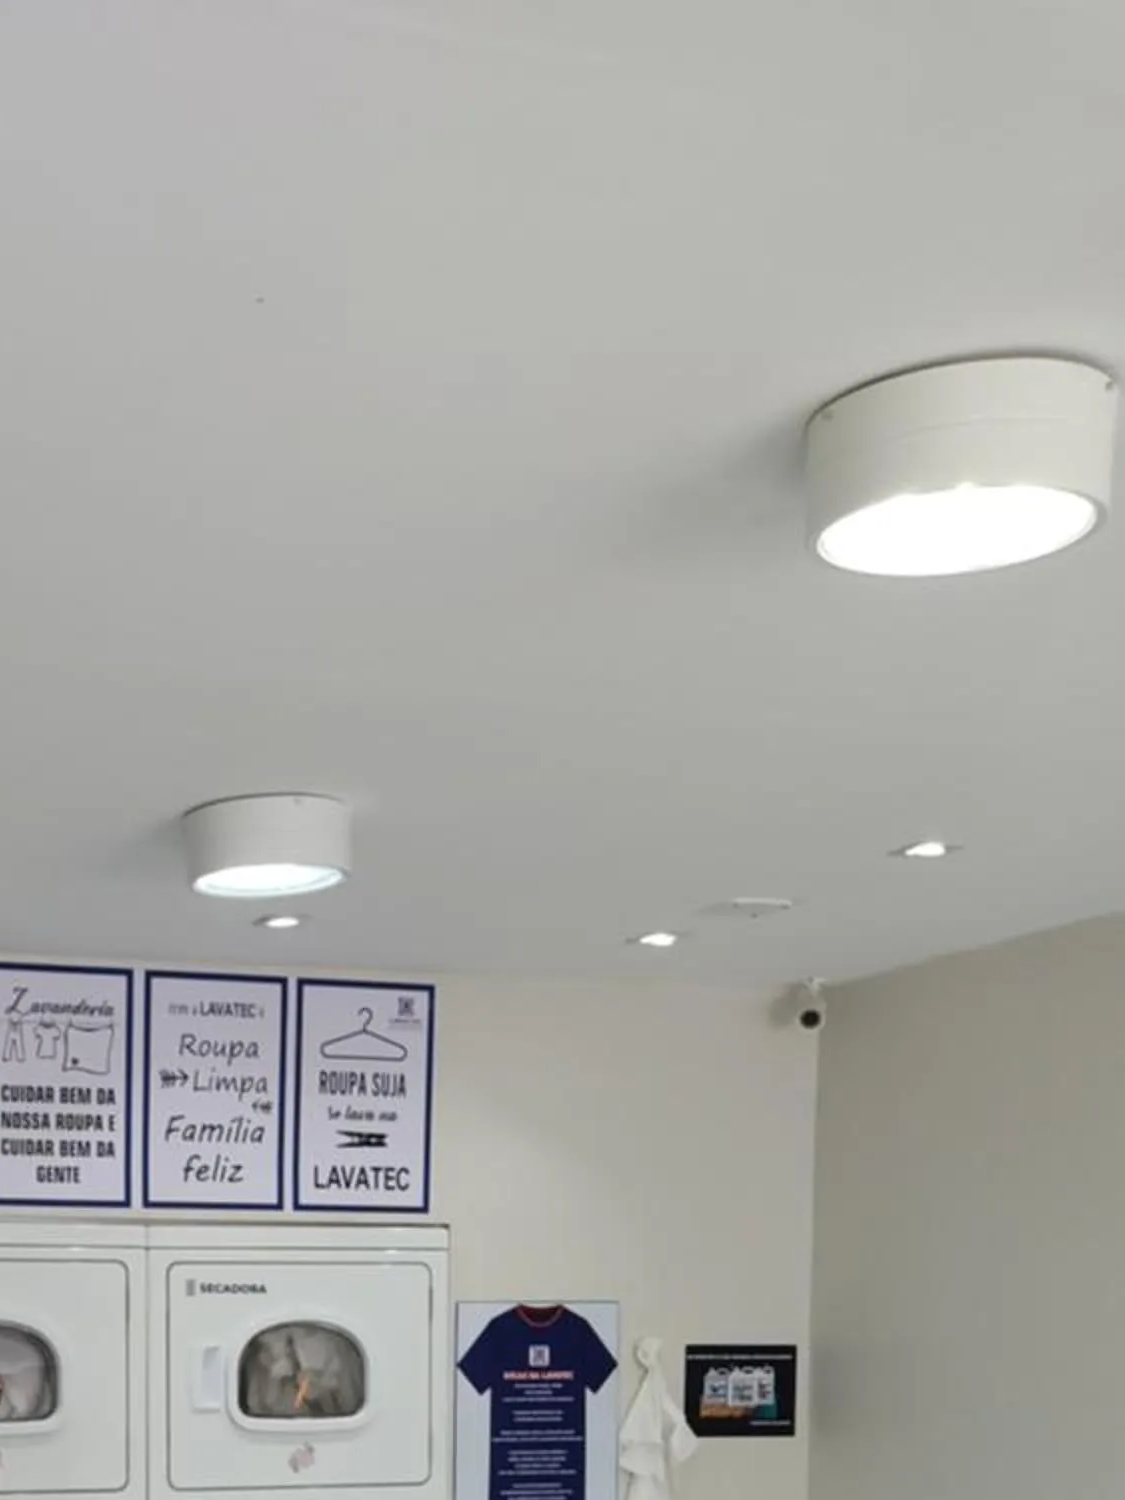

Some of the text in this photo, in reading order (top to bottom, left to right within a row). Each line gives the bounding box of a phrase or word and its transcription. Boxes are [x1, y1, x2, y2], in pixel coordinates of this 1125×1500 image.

[199, 1000, 257, 1018] LAVATEC
[178, 1033, 260, 1066] Roupa
[0, 1084, 116, 1105] CUIDAR BEM DA
[192, 1067, 269, 1101] Limpa
[318, 1069, 407, 1099] ROUPA SUJA
[0, 1111, 115, 1131] NOSSA ROUPA E
[164, 1114, 265, 1144] Família
[0, 1138, 116, 1158] CUIDAR BEM DA
[36, 1165, 81, 1184] GENTE
[183, 1153, 245, 1184] feliz
[313, 1164, 411, 1191] LAVATEC
[199, 1282, 267, 1295] SECADORA
